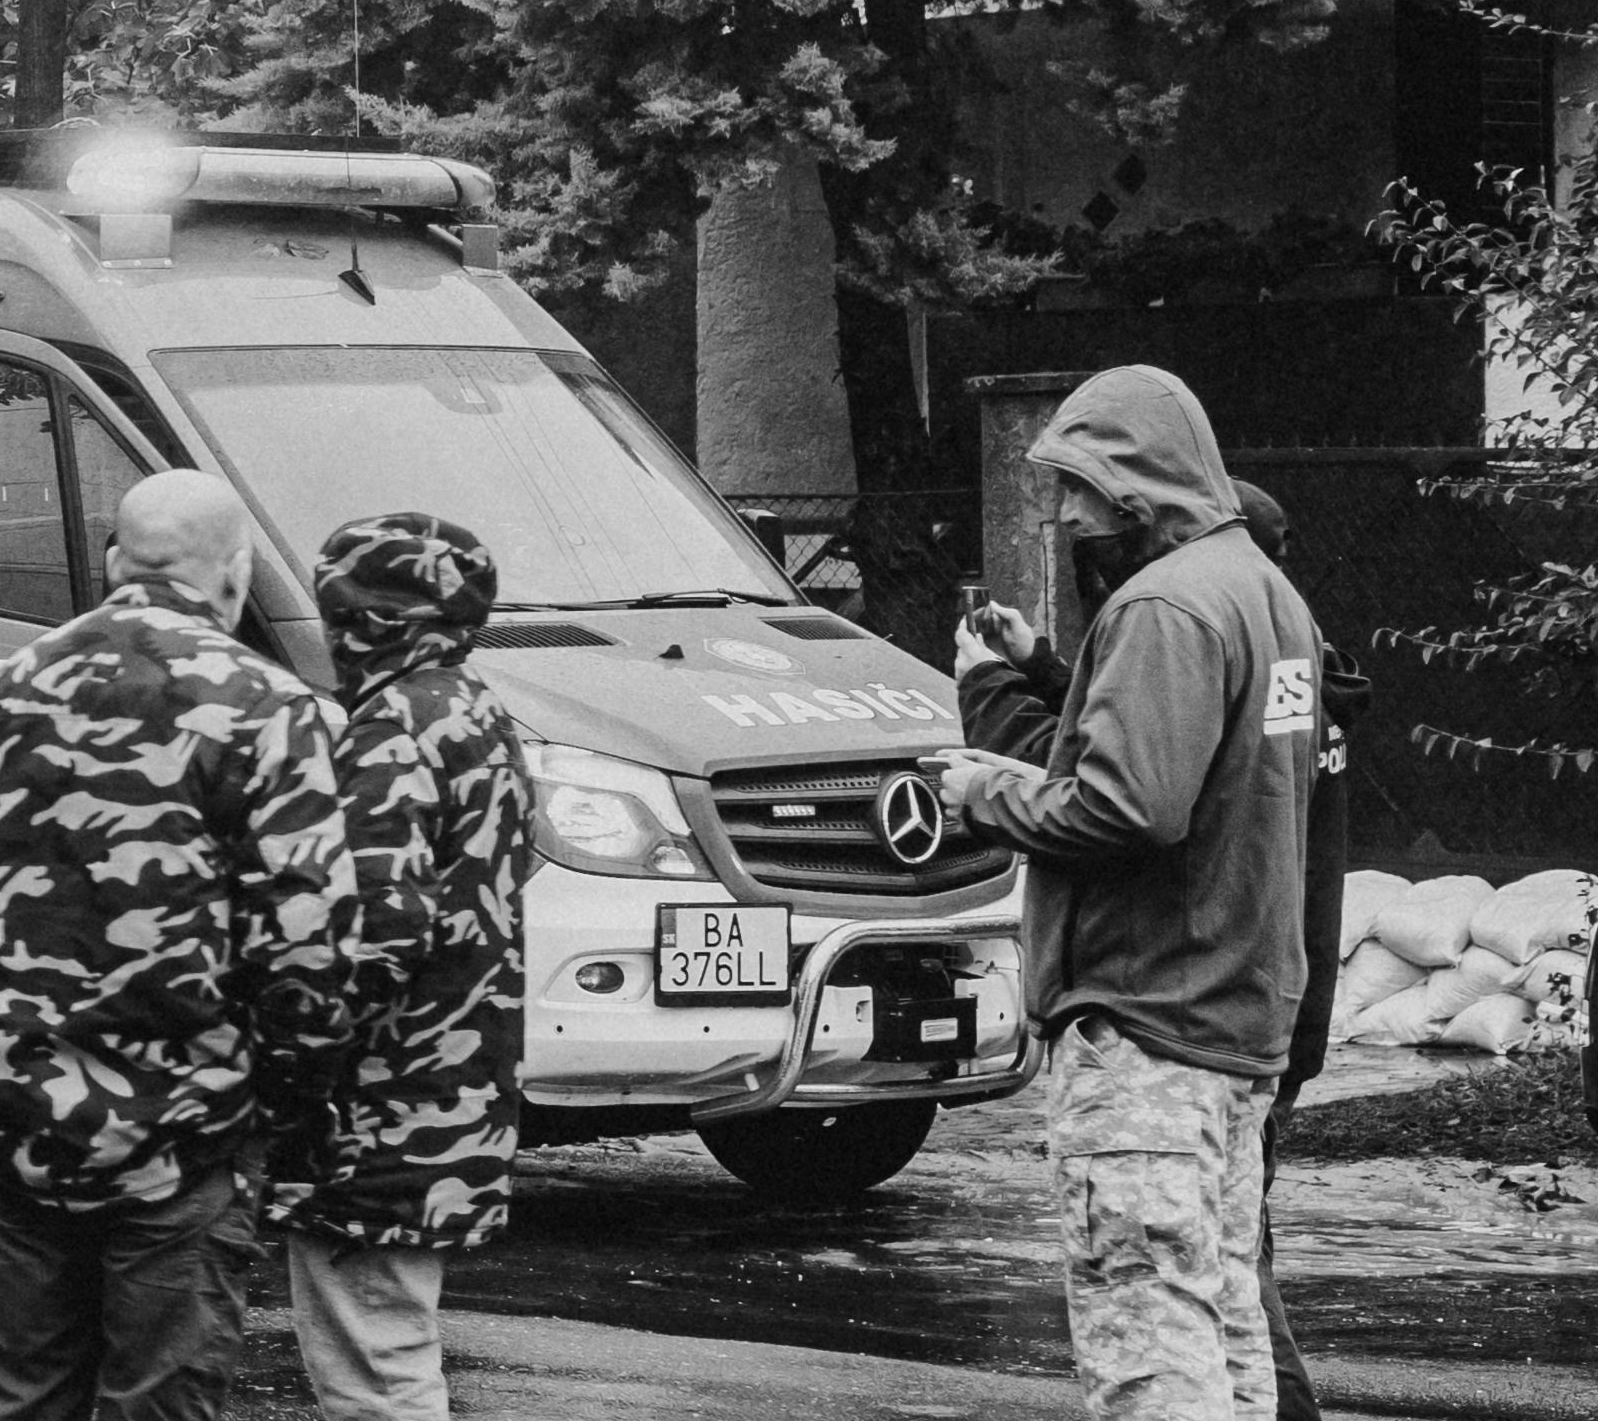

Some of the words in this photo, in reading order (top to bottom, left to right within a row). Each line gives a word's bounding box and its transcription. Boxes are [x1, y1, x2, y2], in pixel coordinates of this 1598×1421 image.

[700, 682, 954, 727] HASIČI
[704, 912, 743, 947] BA
[671, 951, 777, 987] 376LL
